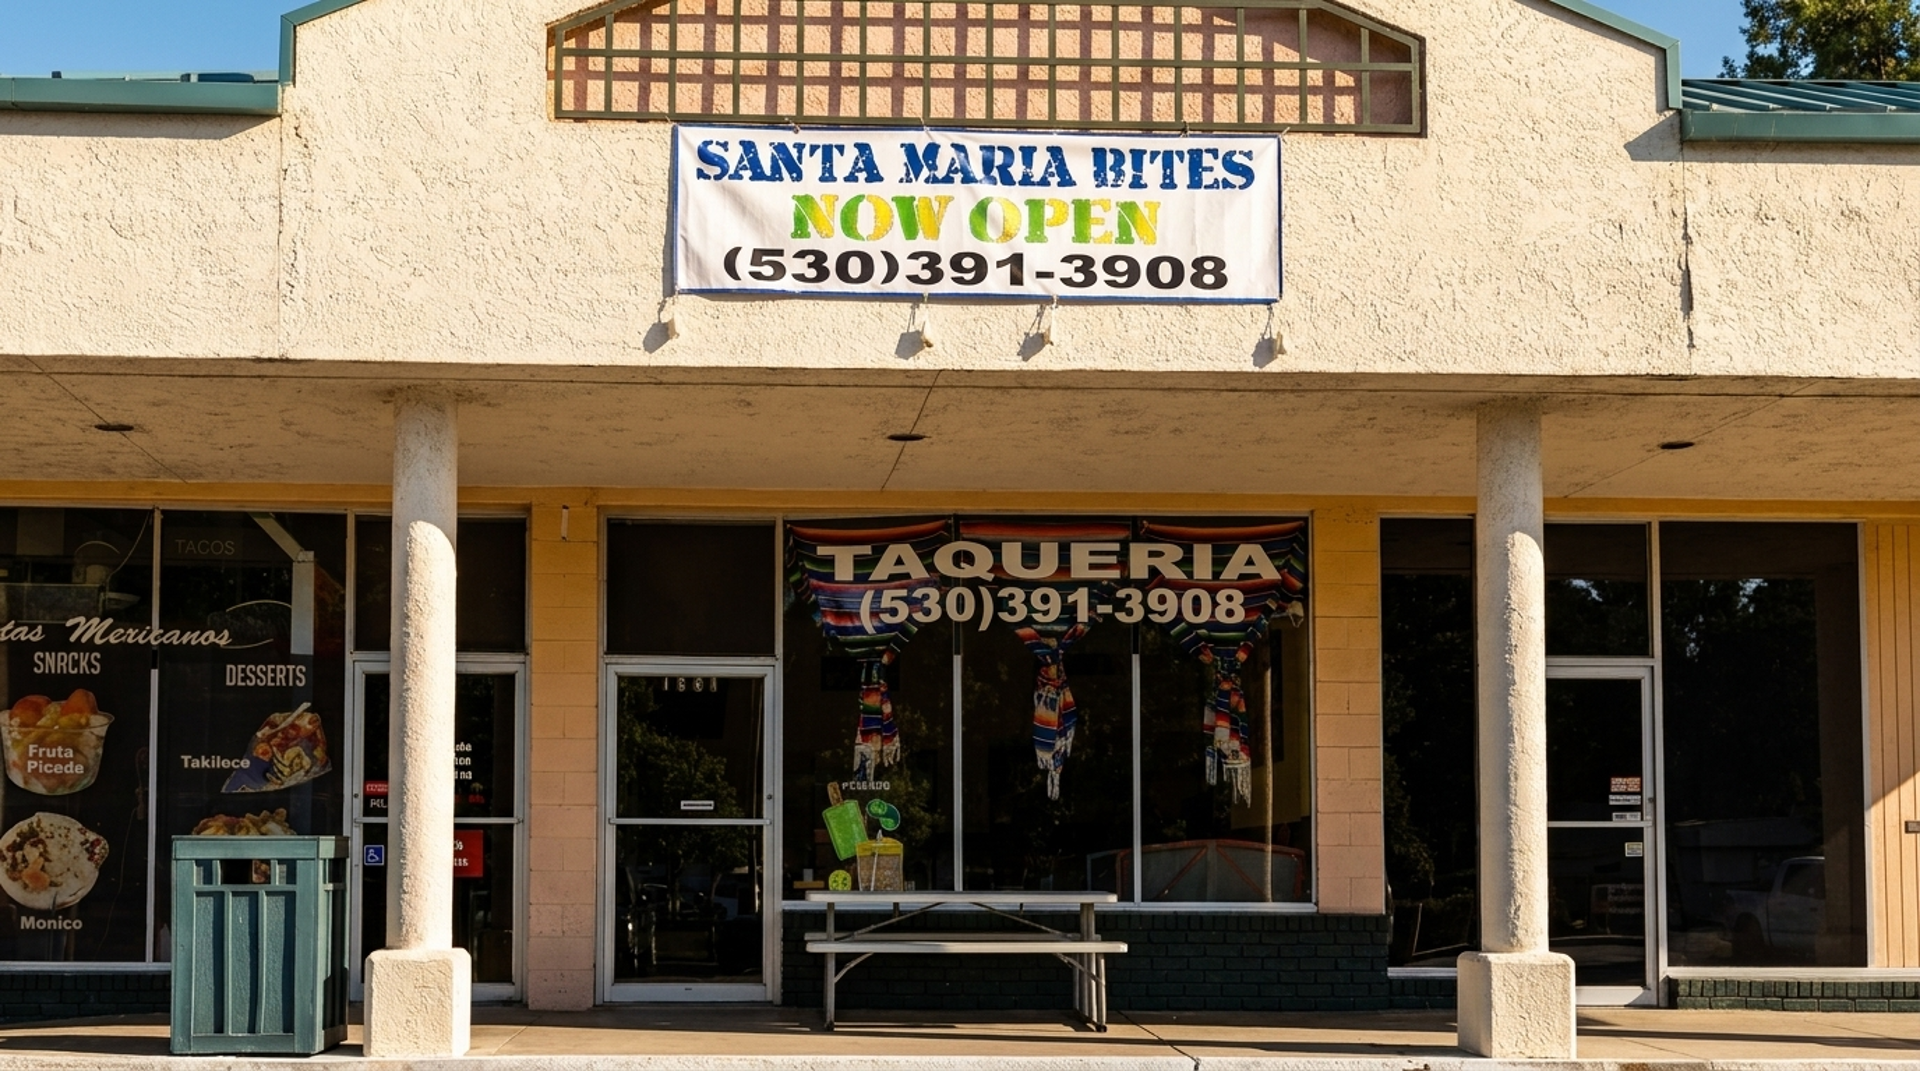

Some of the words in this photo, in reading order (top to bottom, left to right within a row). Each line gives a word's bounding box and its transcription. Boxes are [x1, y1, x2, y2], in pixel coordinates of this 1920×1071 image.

[697, 139, 884, 184] SANTA
[900, 142, 1076, 188] MARIA
[1092, 147, 1256, 191] BITES
[790, 193, 954, 242] NOW
[968, 195, 1162, 245] OPEN
[723, 246, 1229, 291] (530)391-3908
[175, 538, 236, 555] TACOS
[816, 541, 1282, 581] TAQUERIA
[858, 586, 1246, 633] (530)391-3908
[225, 664, 307, 687] DESSERTS
[28, 744, 74, 758] Fruta
[181, 755, 250, 769] Takilece
[20, 915, 83, 930] Monico
